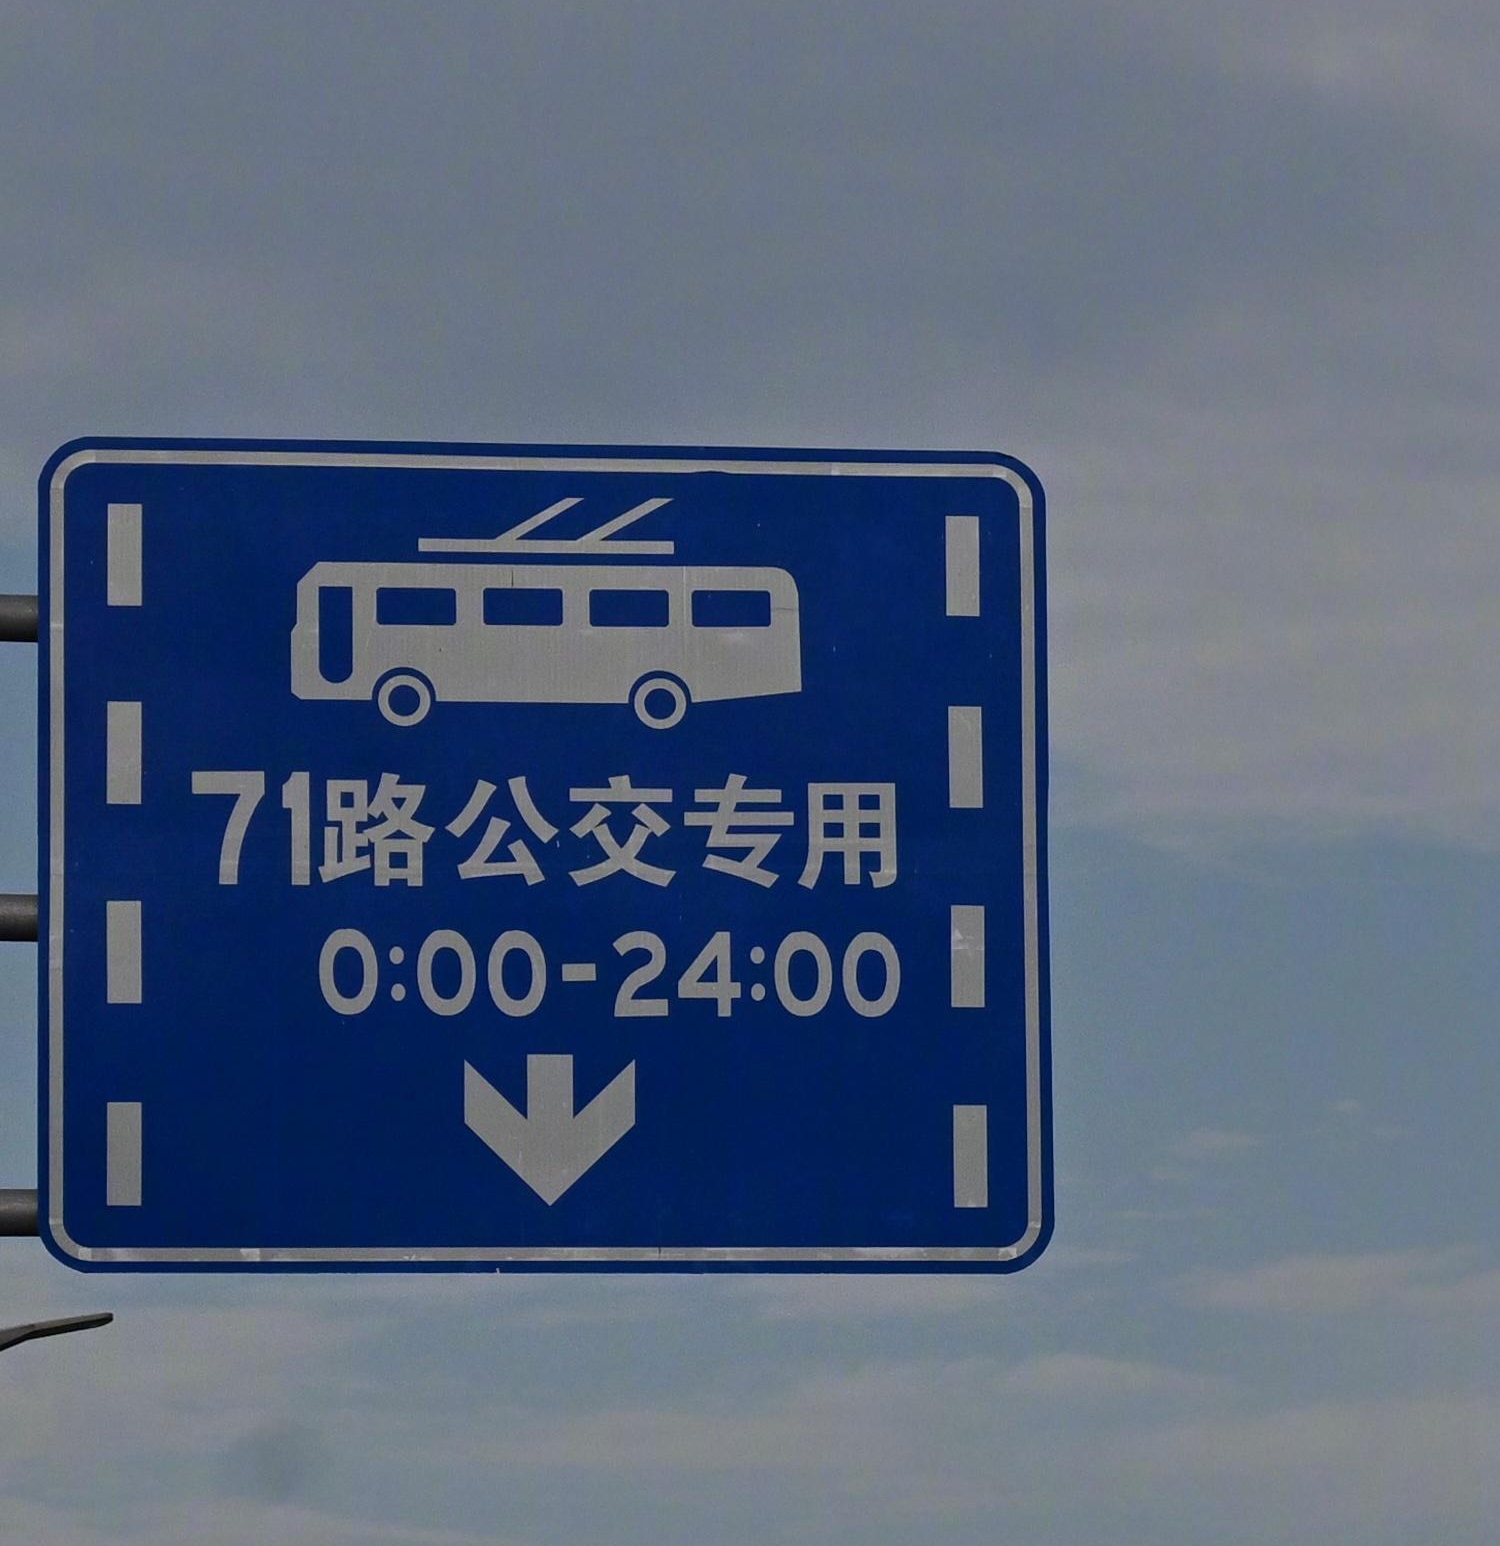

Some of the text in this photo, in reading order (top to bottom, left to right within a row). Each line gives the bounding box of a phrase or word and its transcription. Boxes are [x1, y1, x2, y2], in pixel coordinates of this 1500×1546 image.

[191, 770, 898, 889] 71路公交专用
[318, 927, 901, 1018] 0:00-24:00
